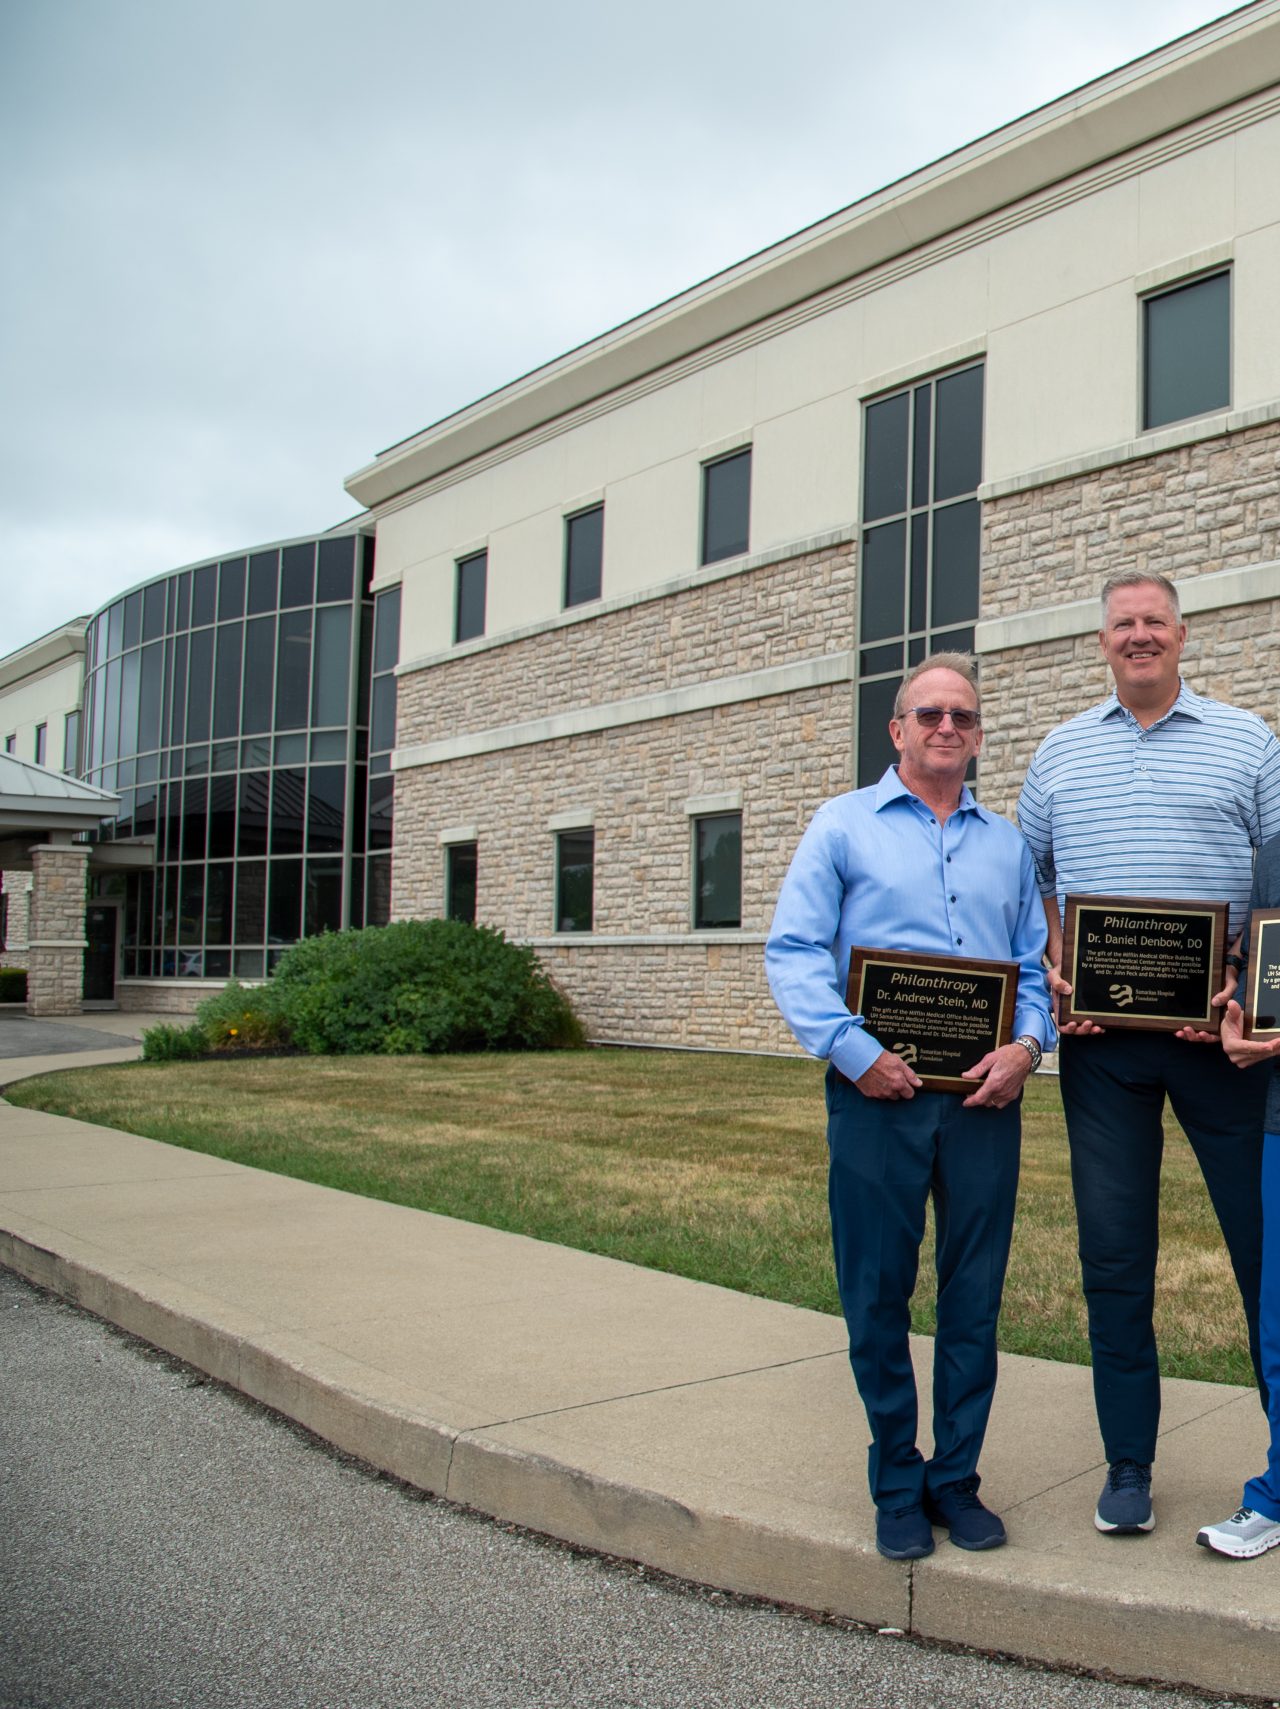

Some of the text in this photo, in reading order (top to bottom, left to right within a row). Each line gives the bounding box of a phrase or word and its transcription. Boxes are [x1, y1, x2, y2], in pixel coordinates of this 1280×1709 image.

[1104, 917, 1187, 933] Philanthropy
[1088, 933, 1202, 949] Dr. Daniel Denbow, DO
[891, 973, 977, 994] Philanthropy
[877, 989, 988, 1009] Dr. Andrew Stein, MD
